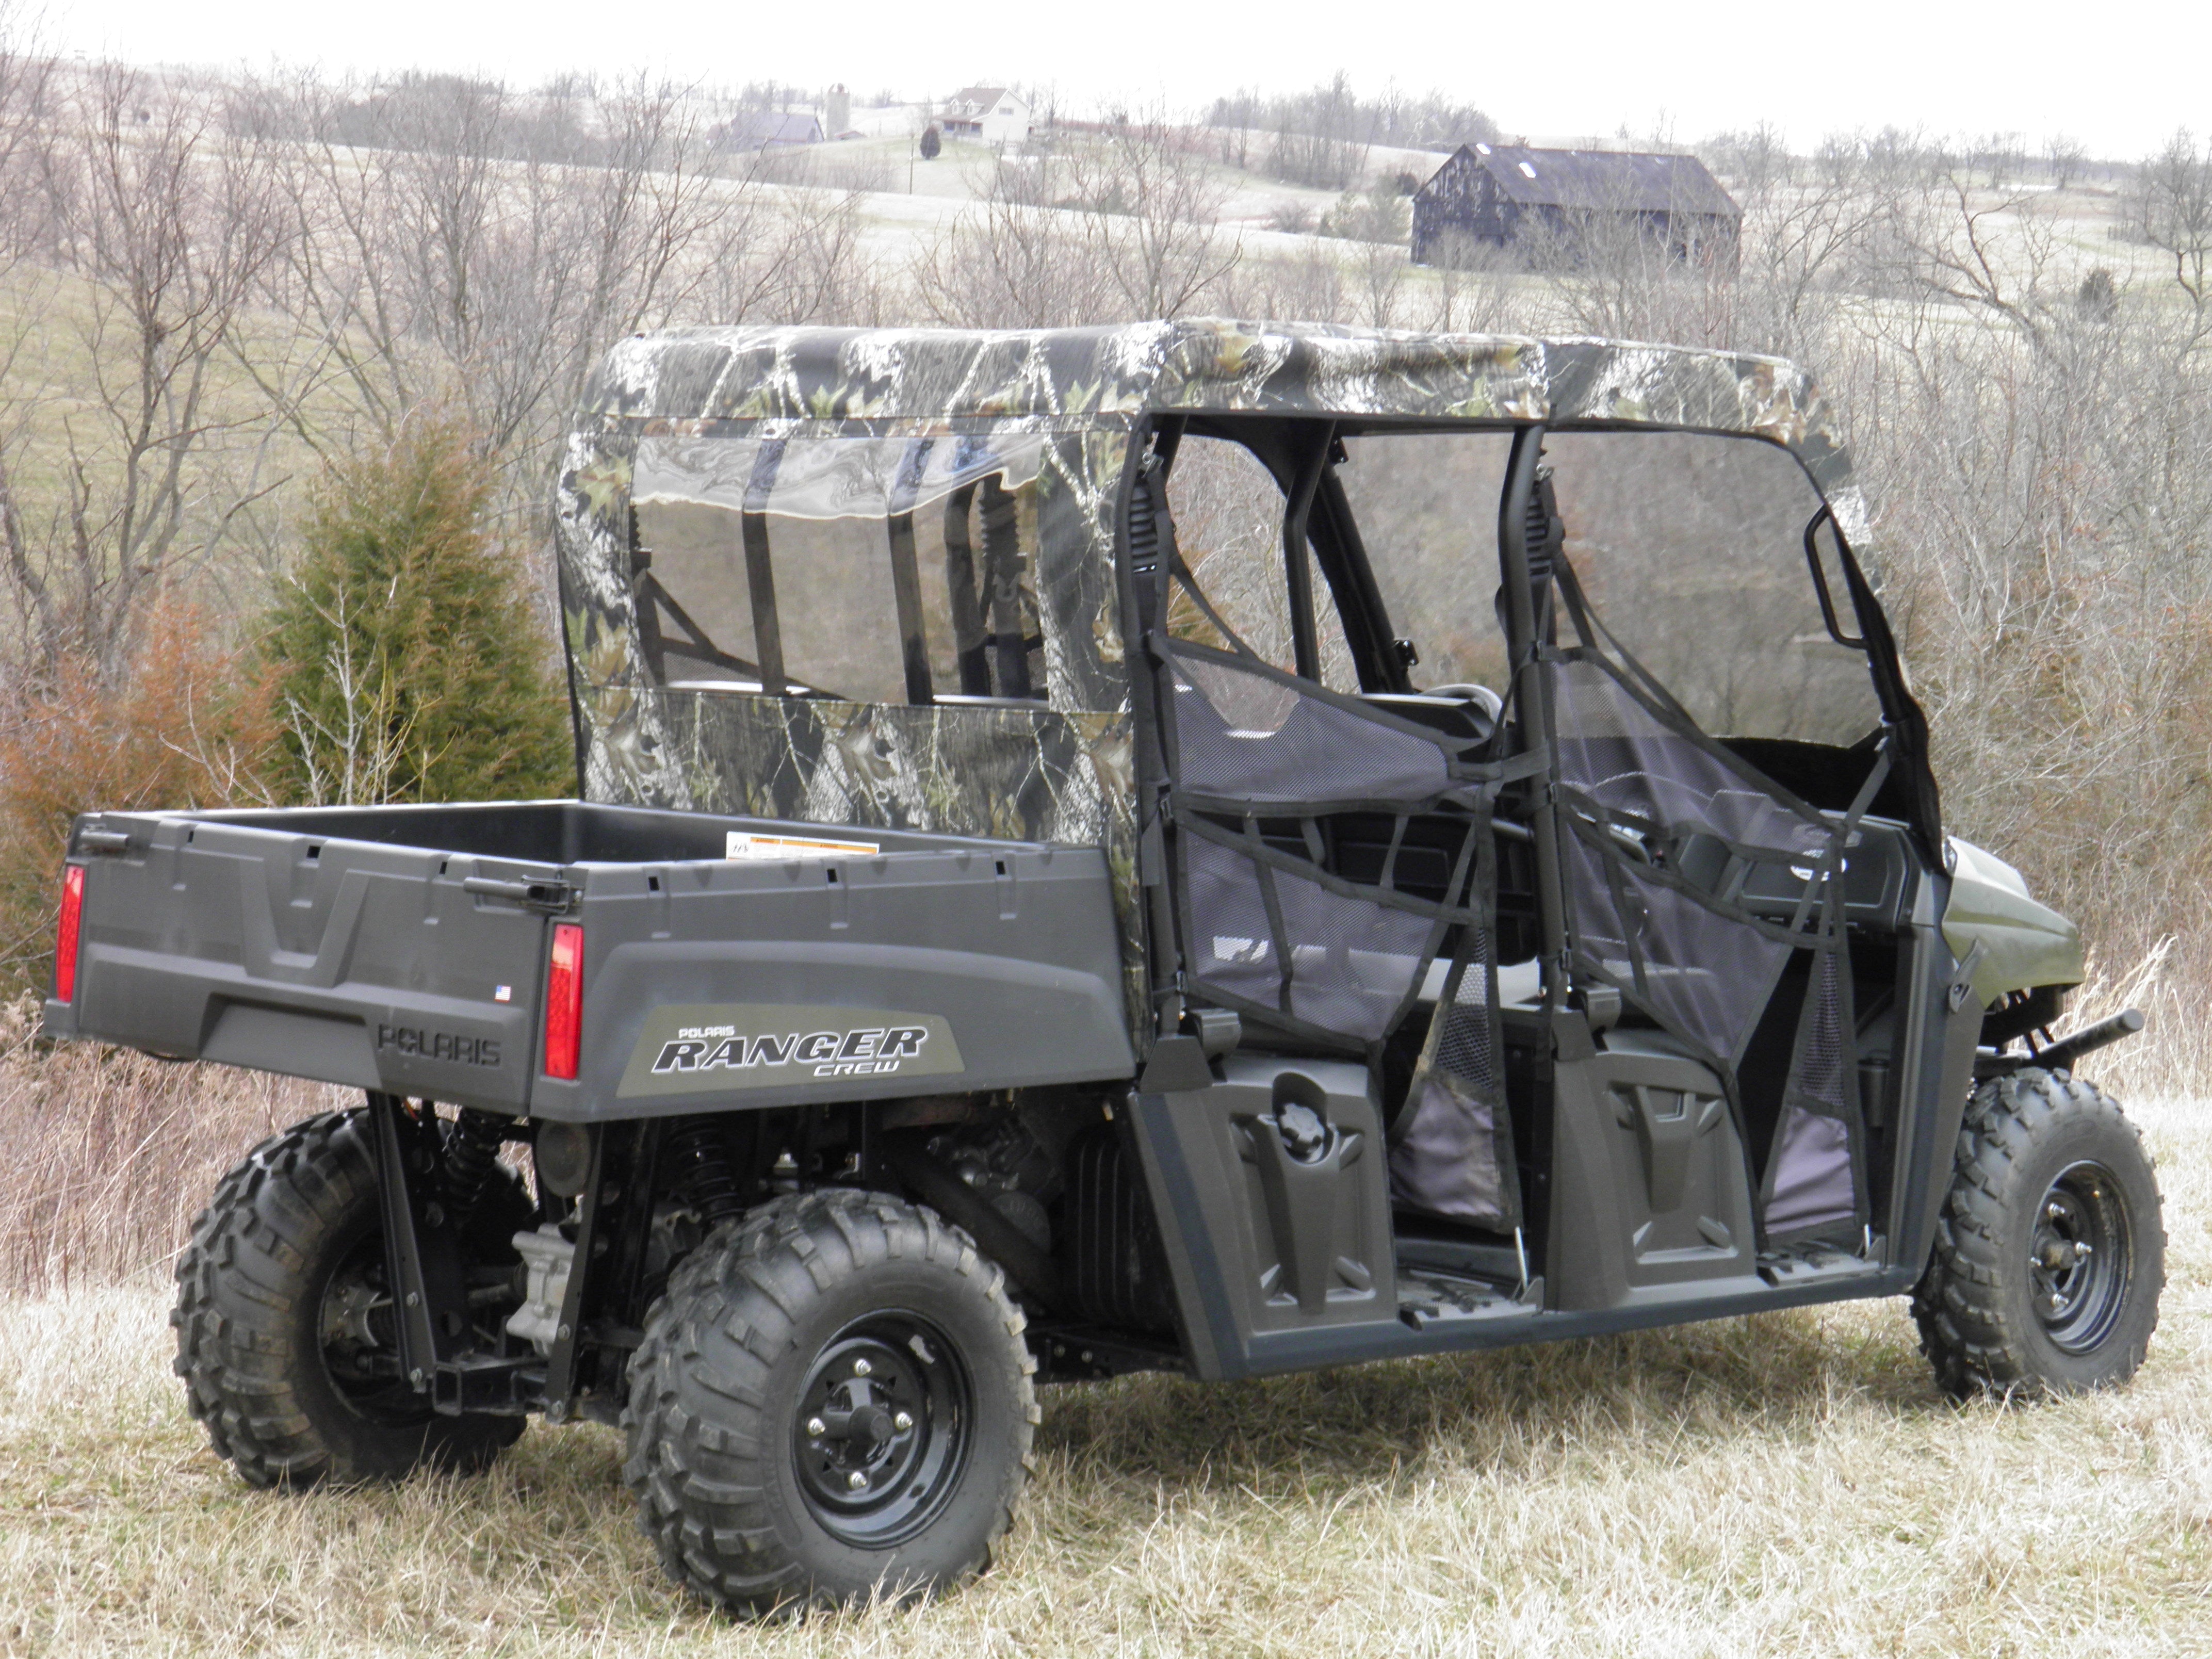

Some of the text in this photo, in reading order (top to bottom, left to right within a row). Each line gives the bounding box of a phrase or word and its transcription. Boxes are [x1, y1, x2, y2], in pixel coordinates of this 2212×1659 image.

[378, 1024, 502, 1067] POLARIS
[678, 1026, 735, 1039] POLARIS
[650, 1026, 928, 1074] RANGER
[814, 1061, 900, 1077] CREW
